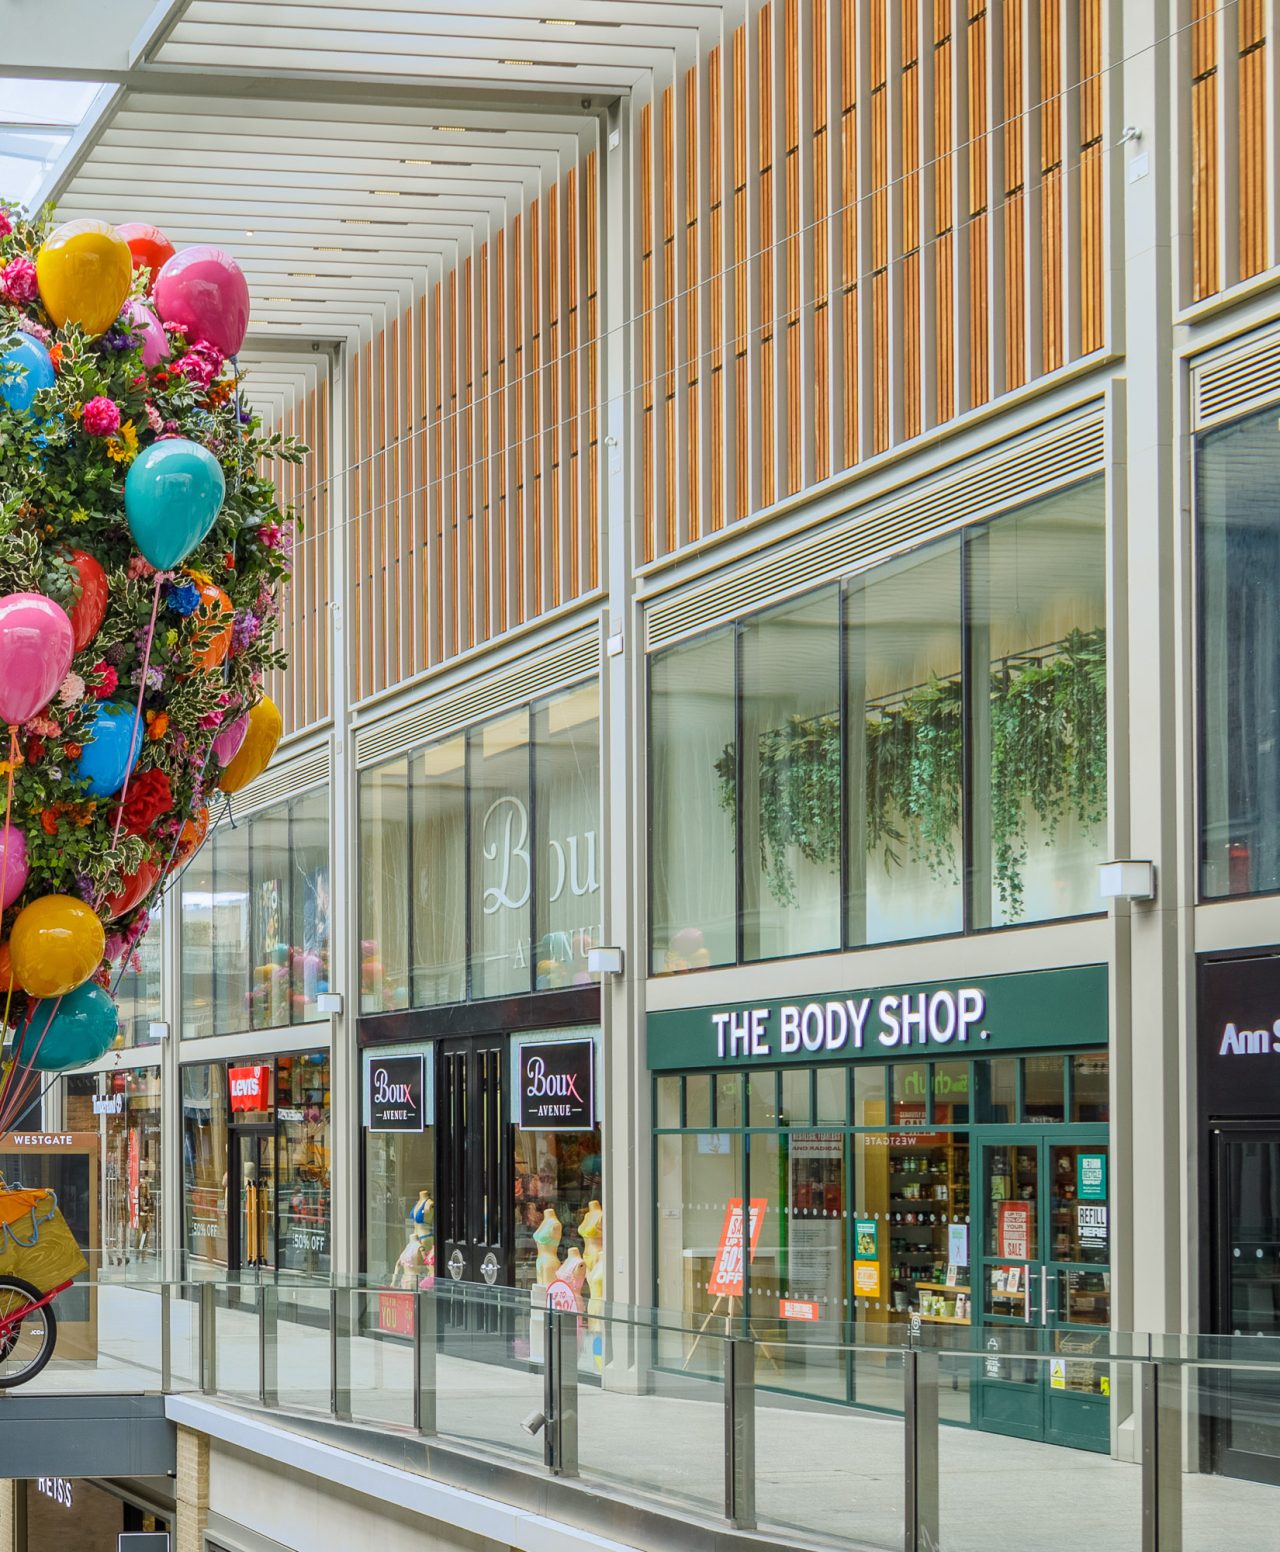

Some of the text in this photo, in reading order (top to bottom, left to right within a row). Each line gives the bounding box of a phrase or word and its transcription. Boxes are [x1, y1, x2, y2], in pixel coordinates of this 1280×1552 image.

[712, 1008, 770, 1057] THE
[780, 997, 870, 1053] BODY
[1219, 1022, 1269, 1055] Ann
[527, 1056, 583, 1103] Boux
[374, 1068, 416, 1109] Boux
[382, 1110, 408, 1120] AVENUE
[537, 1104, 571, 1116] AVENUE
[13, 1135, 73, 1145] WESTGATE
[1079, 1208, 1105, 1225] REFILL
[206, 1224, 218, 1237] OFF
[311, 1235, 325, 1251] OFF
[1007, 1242, 1022, 1256] SALE
[38, 1477, 72, 1508] REISS
